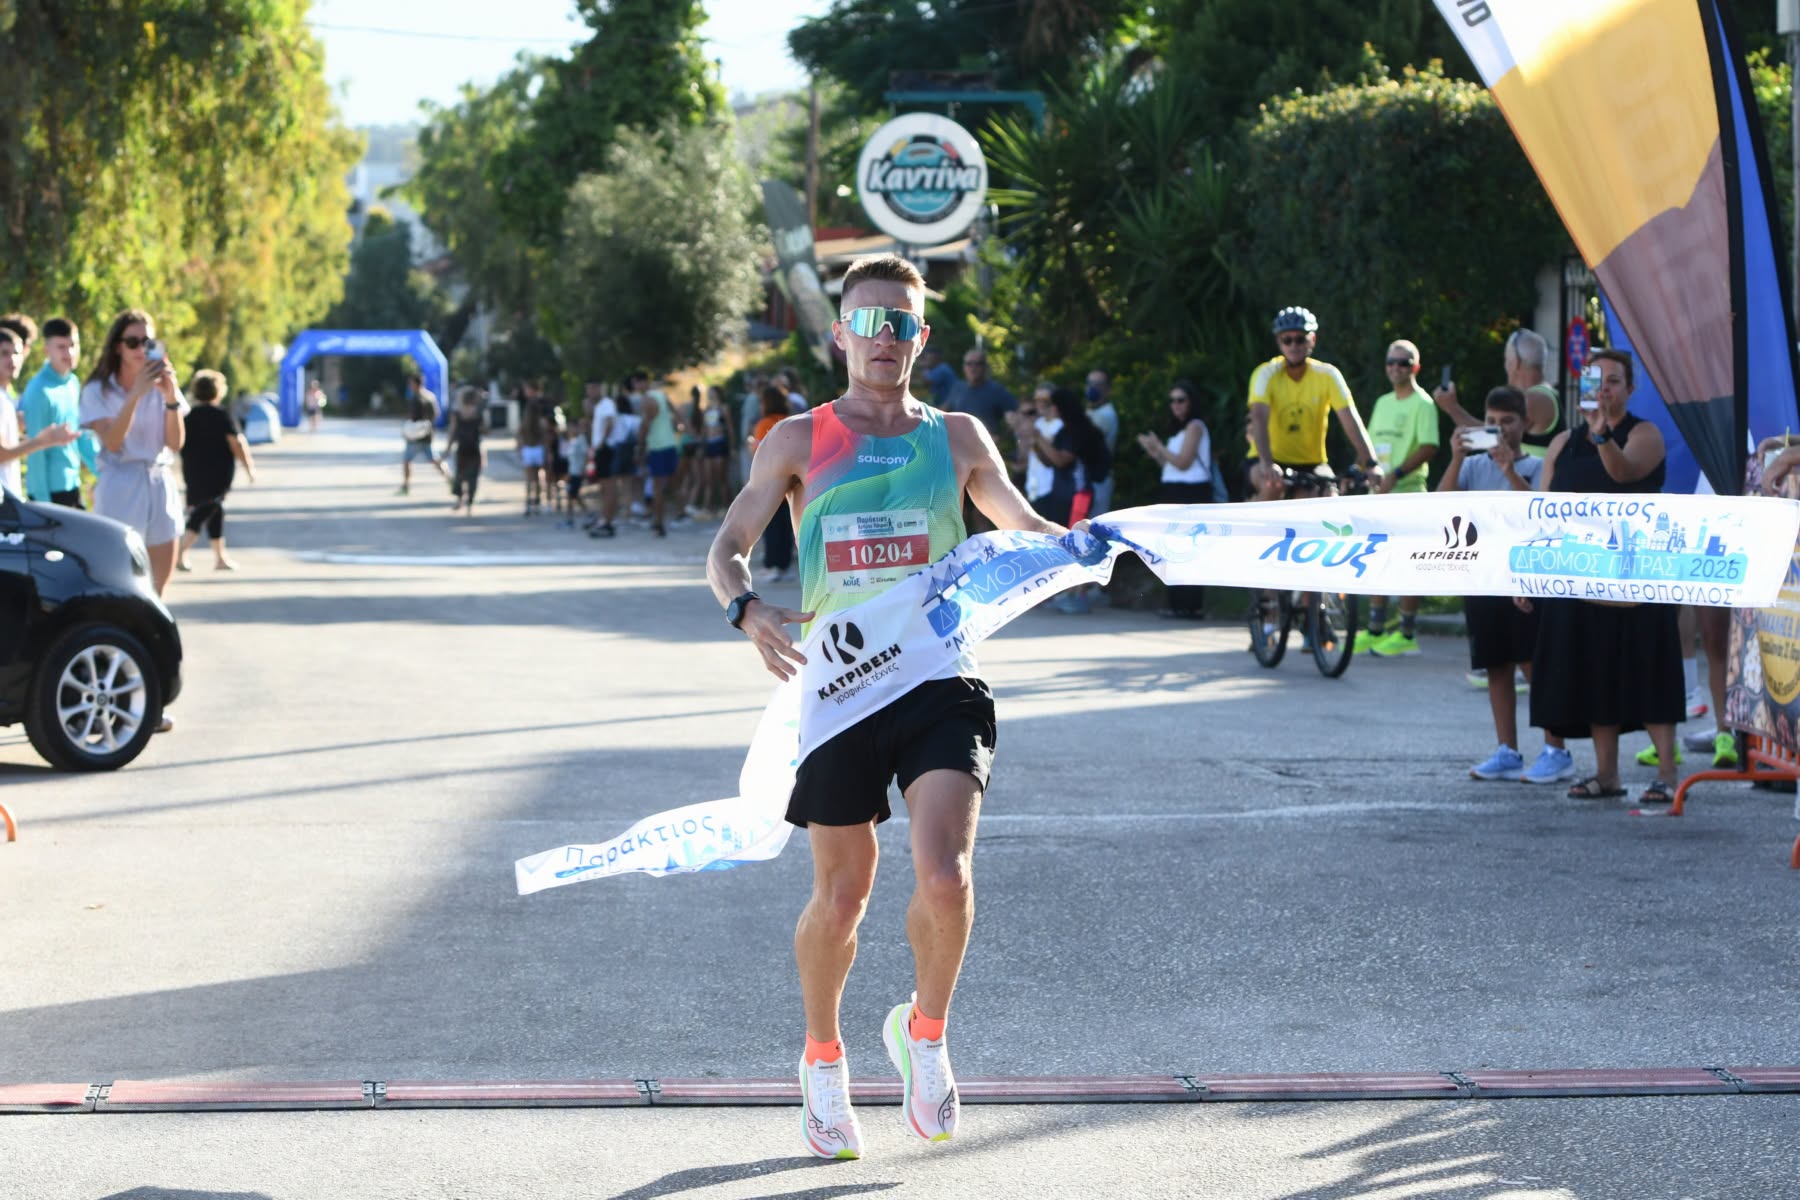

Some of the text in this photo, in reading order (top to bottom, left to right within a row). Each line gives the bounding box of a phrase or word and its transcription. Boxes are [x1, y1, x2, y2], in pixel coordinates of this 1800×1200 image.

[857, 455, 909, 467] saucony
[1528, 497, 1655, 523] Παράκτιος
[848, 541, 914, 566] 10204
[1410, 551, 1479, 560] ΚΑΤΡΙΒΕΣΗ
[1515, 548, 1604, 574] ΔΡΟΜΟΣ
[1608, 553, 1679, 577] ΠΑΤΡΑΣ
[817, 643, 903, 700] ΚΑΤΡΙΒΕΣΗ
[833, 662, 900, 706] γραφικές τέχνες
